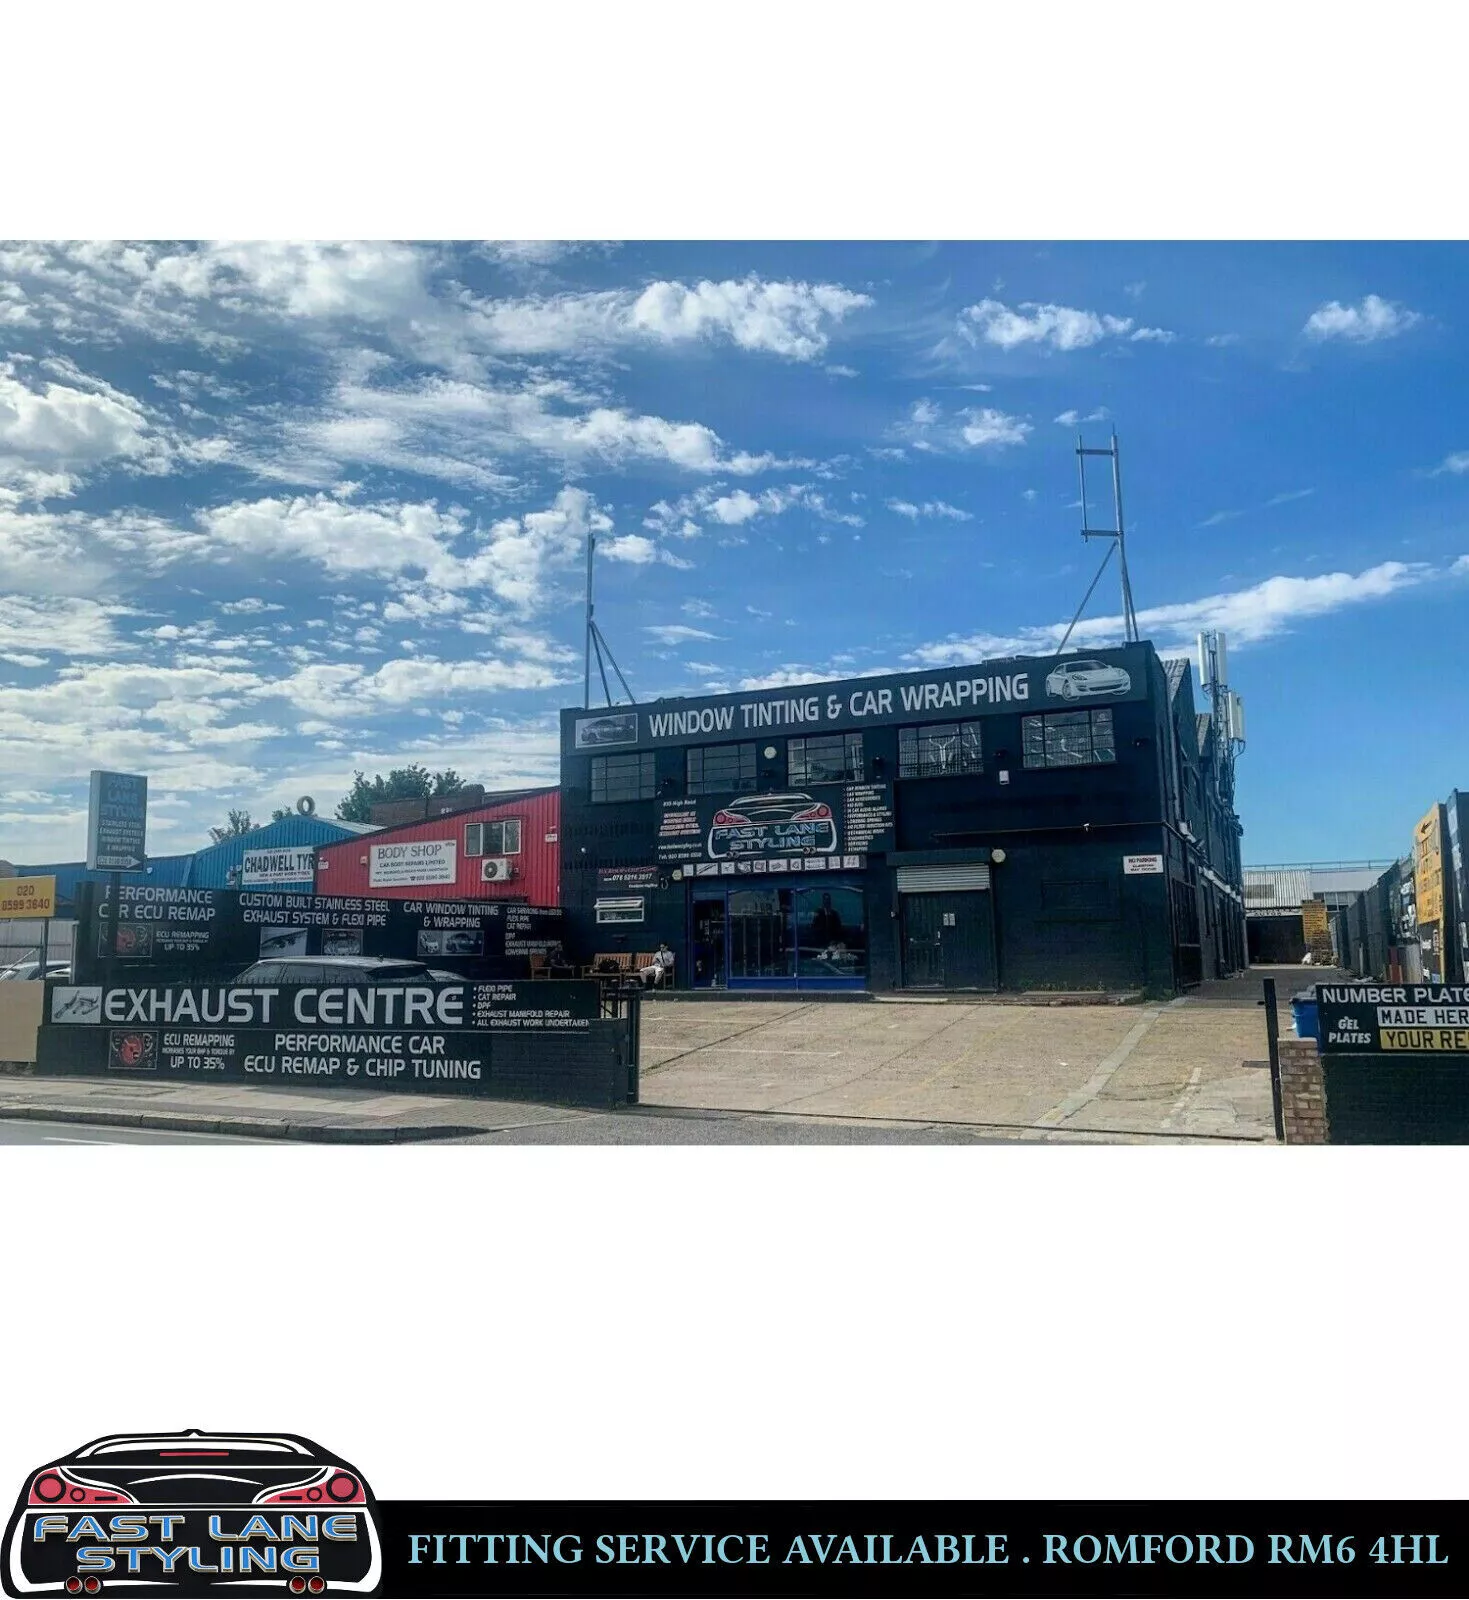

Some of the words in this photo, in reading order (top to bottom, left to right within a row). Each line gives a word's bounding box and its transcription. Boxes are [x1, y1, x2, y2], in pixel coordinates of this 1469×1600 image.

[649, 706, 734, 738] WINDOW
[740, 697, 819, 728] TINTING
[827, 694, 842, 719] &
[849, 689, 893, 717] CAR
[900, 673, 1029, 711] WRAPPING
[715, 826, 769, 840] FAST
[774, 822, 829, 836] LANE
[730, 835, 816, 850] STYLING
[378, 846, 408, 859] BODY
[410, 844, 442, 857] SHOP
[244, 854, 295, 873] CHADWELL
[239, 893, 283, 908] CUSTOM
[286, 895, 313, 909] BUILT
[315, 897, 363, 912] STAINLESS
[364, 899, 390, 912] STEEL
[403, 901, 422, 913] CAR
[426, 902, 466, 915] WINDOW
[467, 903, 499, 916] TINTING
[98, 903, 129, 918] CR
[134, 904, 163, 919] ECU
[168, 906, 216, 921] REMAP
[243, 909, 291, 924] EXHAUST
[292, 911, 330, 925] SYSTEM
[332, 912, 339, 925] &
[366, 914, 387, 926] PIPE
[423, 916, 432, 928] &
[434, 917, 481, 928] WRAPPING
[156, 930, 170, 939] ECU
[172, 930, 210, 940] REMAPPING
[496, 984, 512, 993] PIPE
[1322, 988, 1408, 1004] NUMBER
[477, 993, 490, 1001] CAT
[492, 994, 516, 1002] REPAIR
[104, 987, 279, 1024] EXHAUST
[294, 987, 464, 1025] CENTRE
[477, 1002, 490, 1010] DPF
[477, 1010, 508, 1018] EXHAUST
[508, 1010, 544, 1018] MANIFOLD
[1382, 1009, 1428, 1024] MADE
[477, 1018, 489, 1026] ALL
[1338, 1018, 1359, 1030] GEL
[164, 1034, 180, 1045] ECU
[182, 1034, 235, 1047] REMAPPING
[274, 1034, 402, 1054] PERFORMANCE
[408, 1036, 445, 1054] CAR
[1328, 1032, 1372, 1044] PLATES
[1386, 1031, 1434, 1048] YOUR
[170, 1056, 184, 1068] UP
[188, 1056, 201, 1068] TO
[203, 1056, 225, 1070] 35%
[244, 1055, 275, 1073] ECU
[282, 1056, 341, 1074] REMAP
[346, 1058, 360, 1075] &
[365, 1058, 406, 1077] CHIP
[412, 1059, 482, 1080] TUNING
